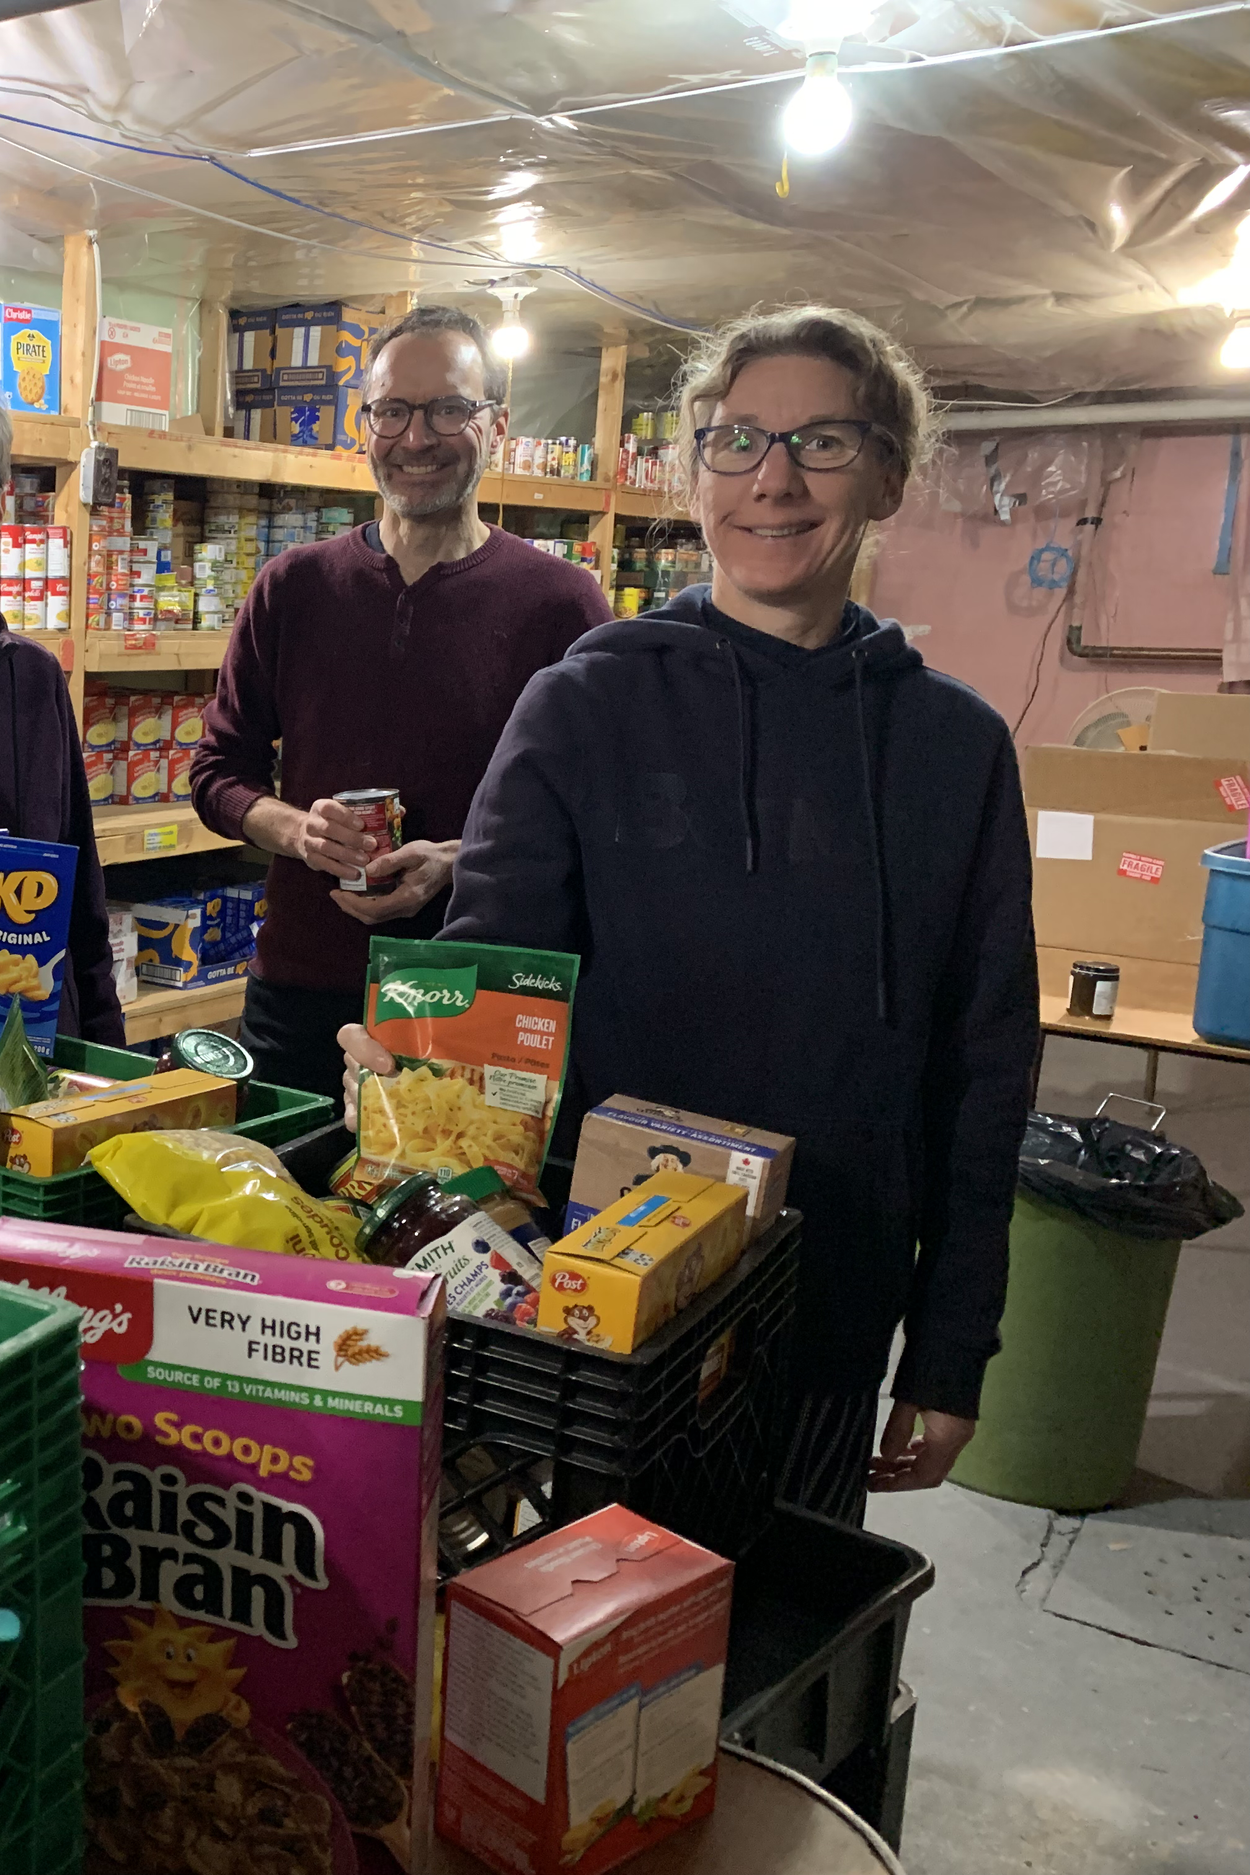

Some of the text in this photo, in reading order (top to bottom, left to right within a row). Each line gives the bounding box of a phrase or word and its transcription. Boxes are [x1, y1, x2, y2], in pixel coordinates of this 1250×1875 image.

[5, 307, 32, 320] Christie
[15, 341, 48, 358] PIRATE
[110, 357, 129, 369] Lipton
[1222, 777, 1249, 810] FRAGILE
[1120, 858, 1163, 877] FRAGILE
[207, 969, 226, 980] GOTTA
[227, 966, 235, 975] BE
[515, 1014, 557, 1033] CHICKEN
[517, 1032, 555, 1050] POULET
[491, 1052, 516, 1064] Pasta
[493, 1069, 537, 1084] Our Promise
[606, 1110, 649, 1125] FLAVOUR
[3, 1128, 21, 1144] Post
[125, 1254, 259, 1285] Raisin Bran
[454, 1260, 490, 1296] CHAMPS
[553, 1271, 586, 1290] Post
[187, 1304, 322, 1345] VERY HIGH
[247, 1340, 321, 1370] FIBRE
[146, 1365, 403, 1420] SOURCE OF 13 VITAMINS & MINERALS
[153, 1410, 316, 1482] Scoops
[82, 1531, 298, 1644] Bran
